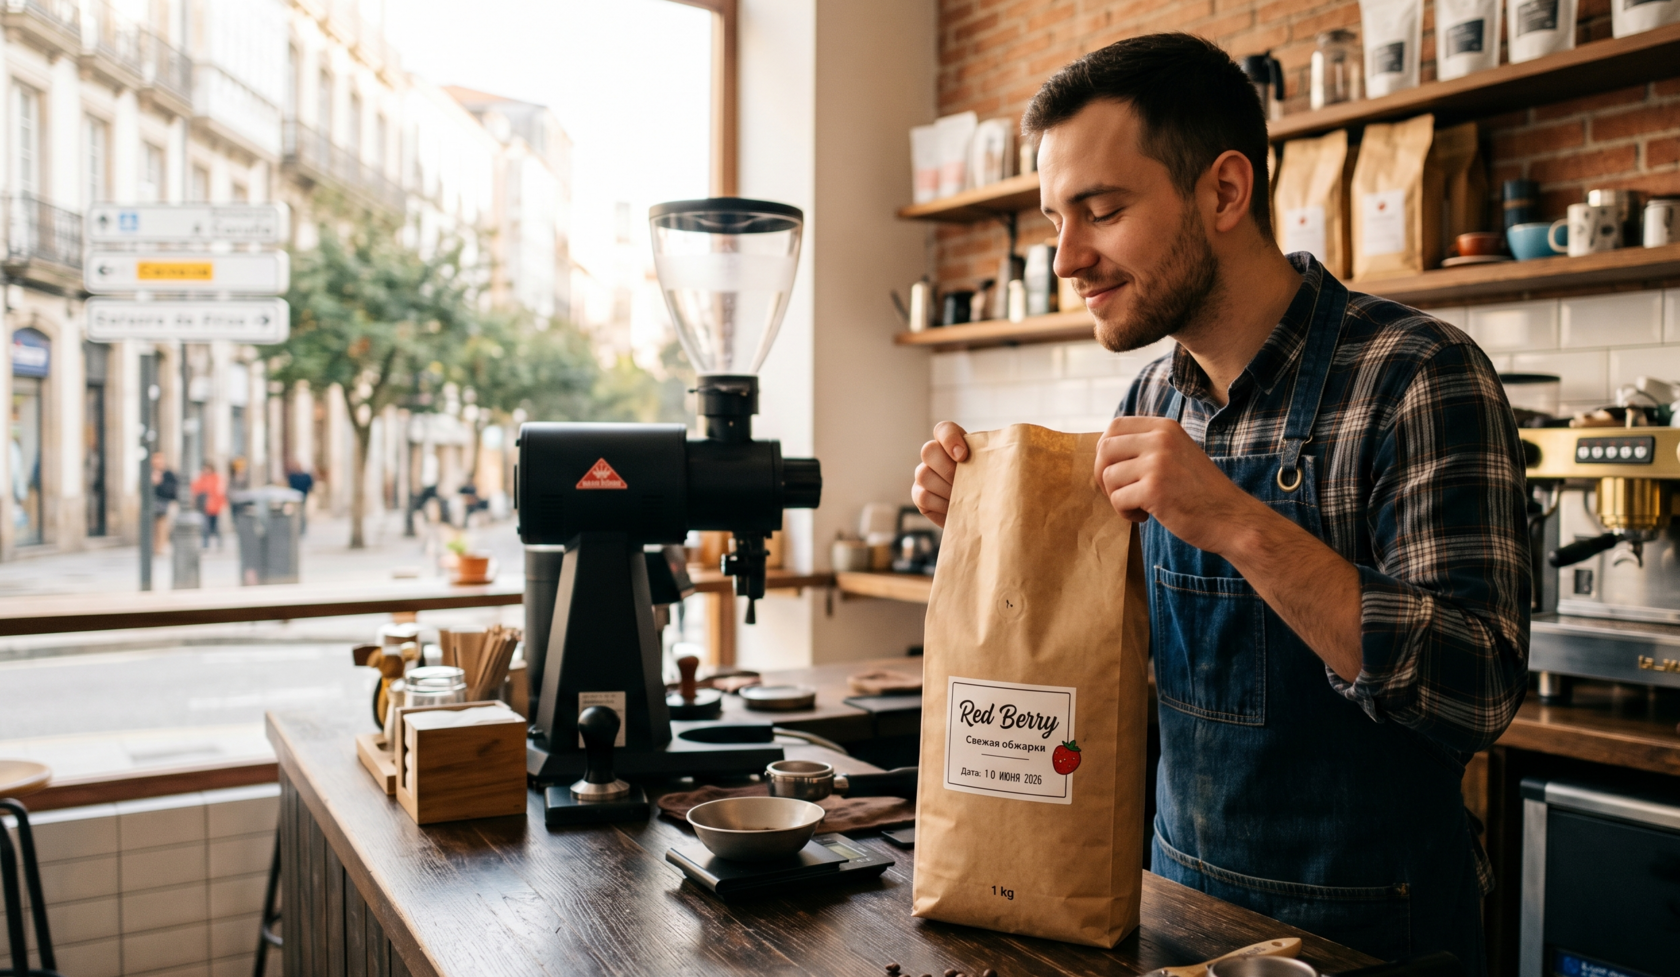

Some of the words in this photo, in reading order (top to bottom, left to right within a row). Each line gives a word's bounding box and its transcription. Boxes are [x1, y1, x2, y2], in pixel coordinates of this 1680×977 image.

[959, 699, 995, 727] Red
[999, 704, 1060, 739] Berry
[966, 735, 1000, 748] Свежая
[1001, 740, 1046, 753] обжарки
[960, 767, 982, 778] Дата:
[999, 771, 1020, 783] ИЮНЯ
[1024, 773, 1042, 785] 2026
[991, 885, 996, 896] 1
[1000, 886, 1014, 900] kg
